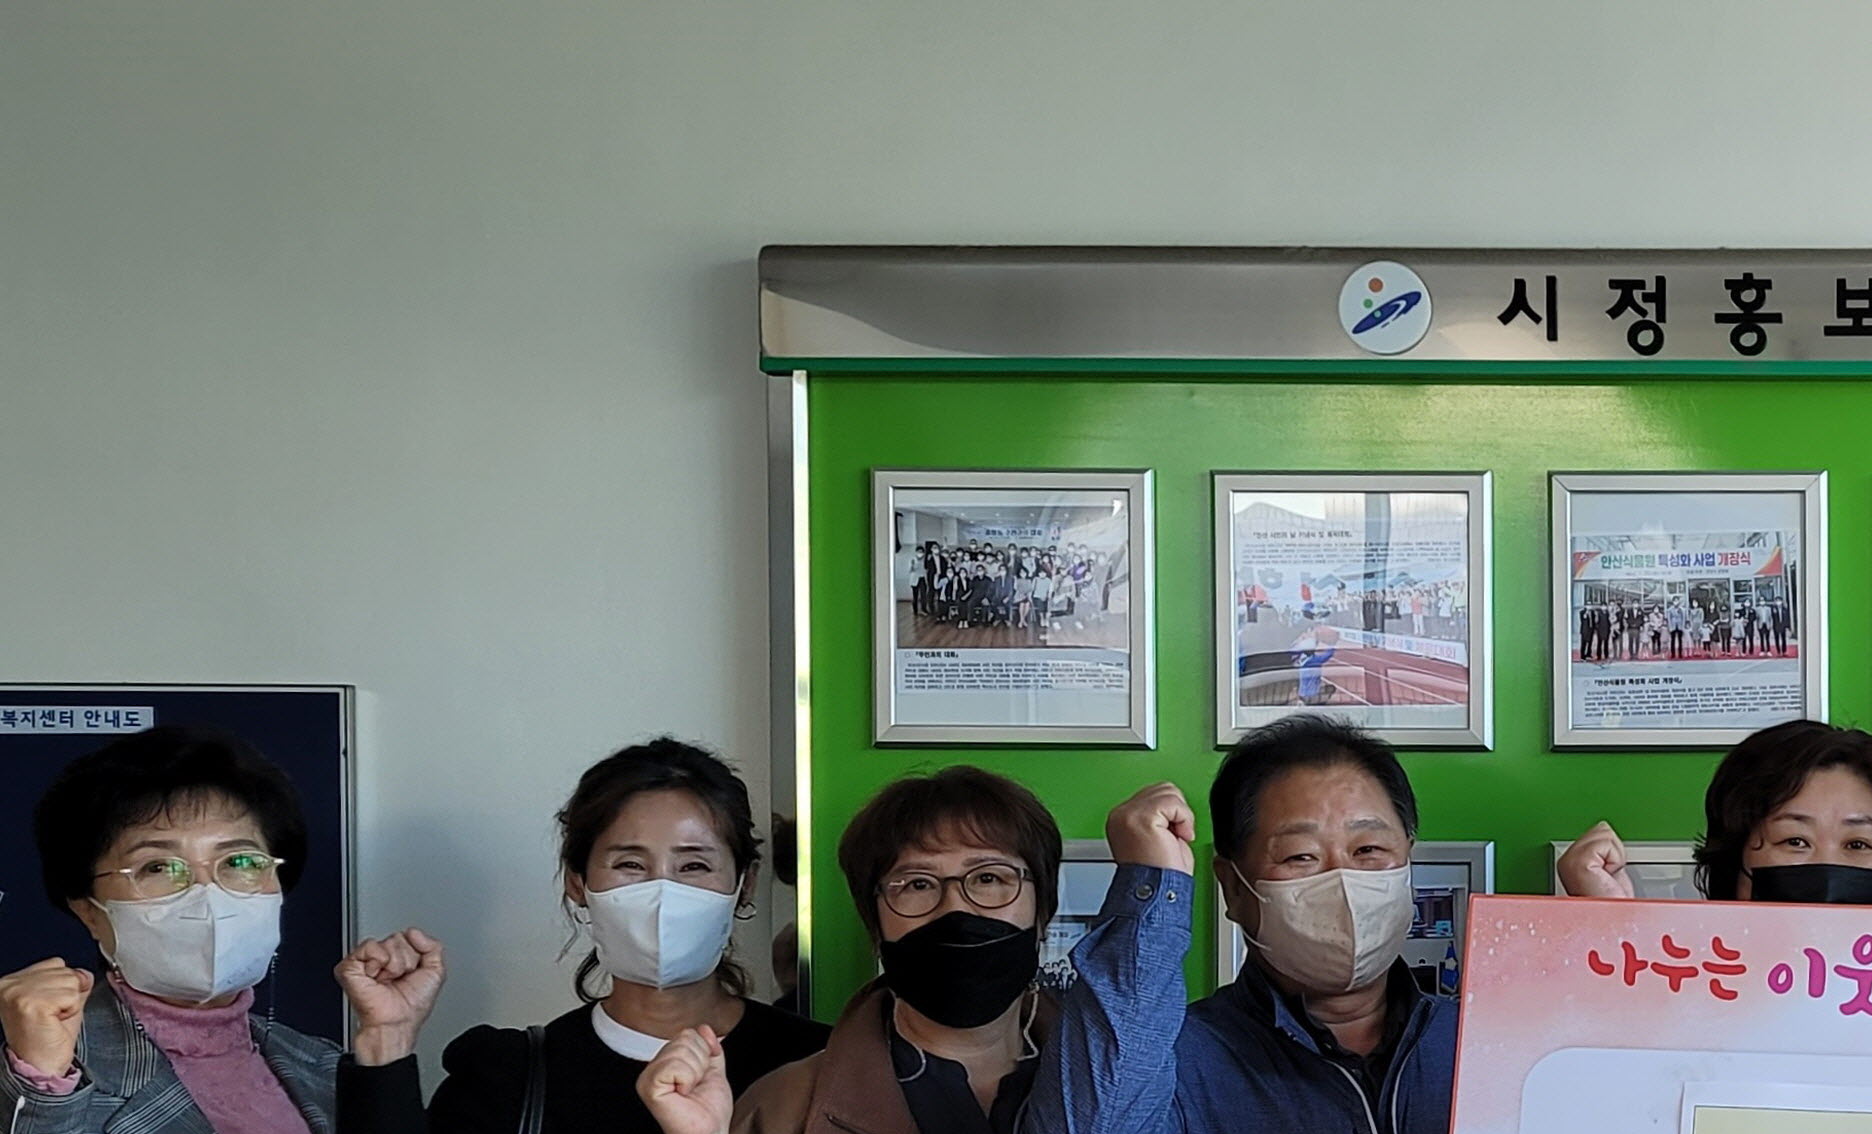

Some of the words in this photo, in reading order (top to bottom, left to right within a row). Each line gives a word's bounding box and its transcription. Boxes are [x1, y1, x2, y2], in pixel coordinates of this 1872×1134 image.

[1601, 555, 1656, 569] 안산식물원
[1658, 554, 1691, 568] 특성화
[1694, 553, 1715, 567] 사업
[1718, 552, 1751, 566] 개장식
[84, 709, 142, 729] 안내도
[1588, 936, 1751, 1000] 나누는
